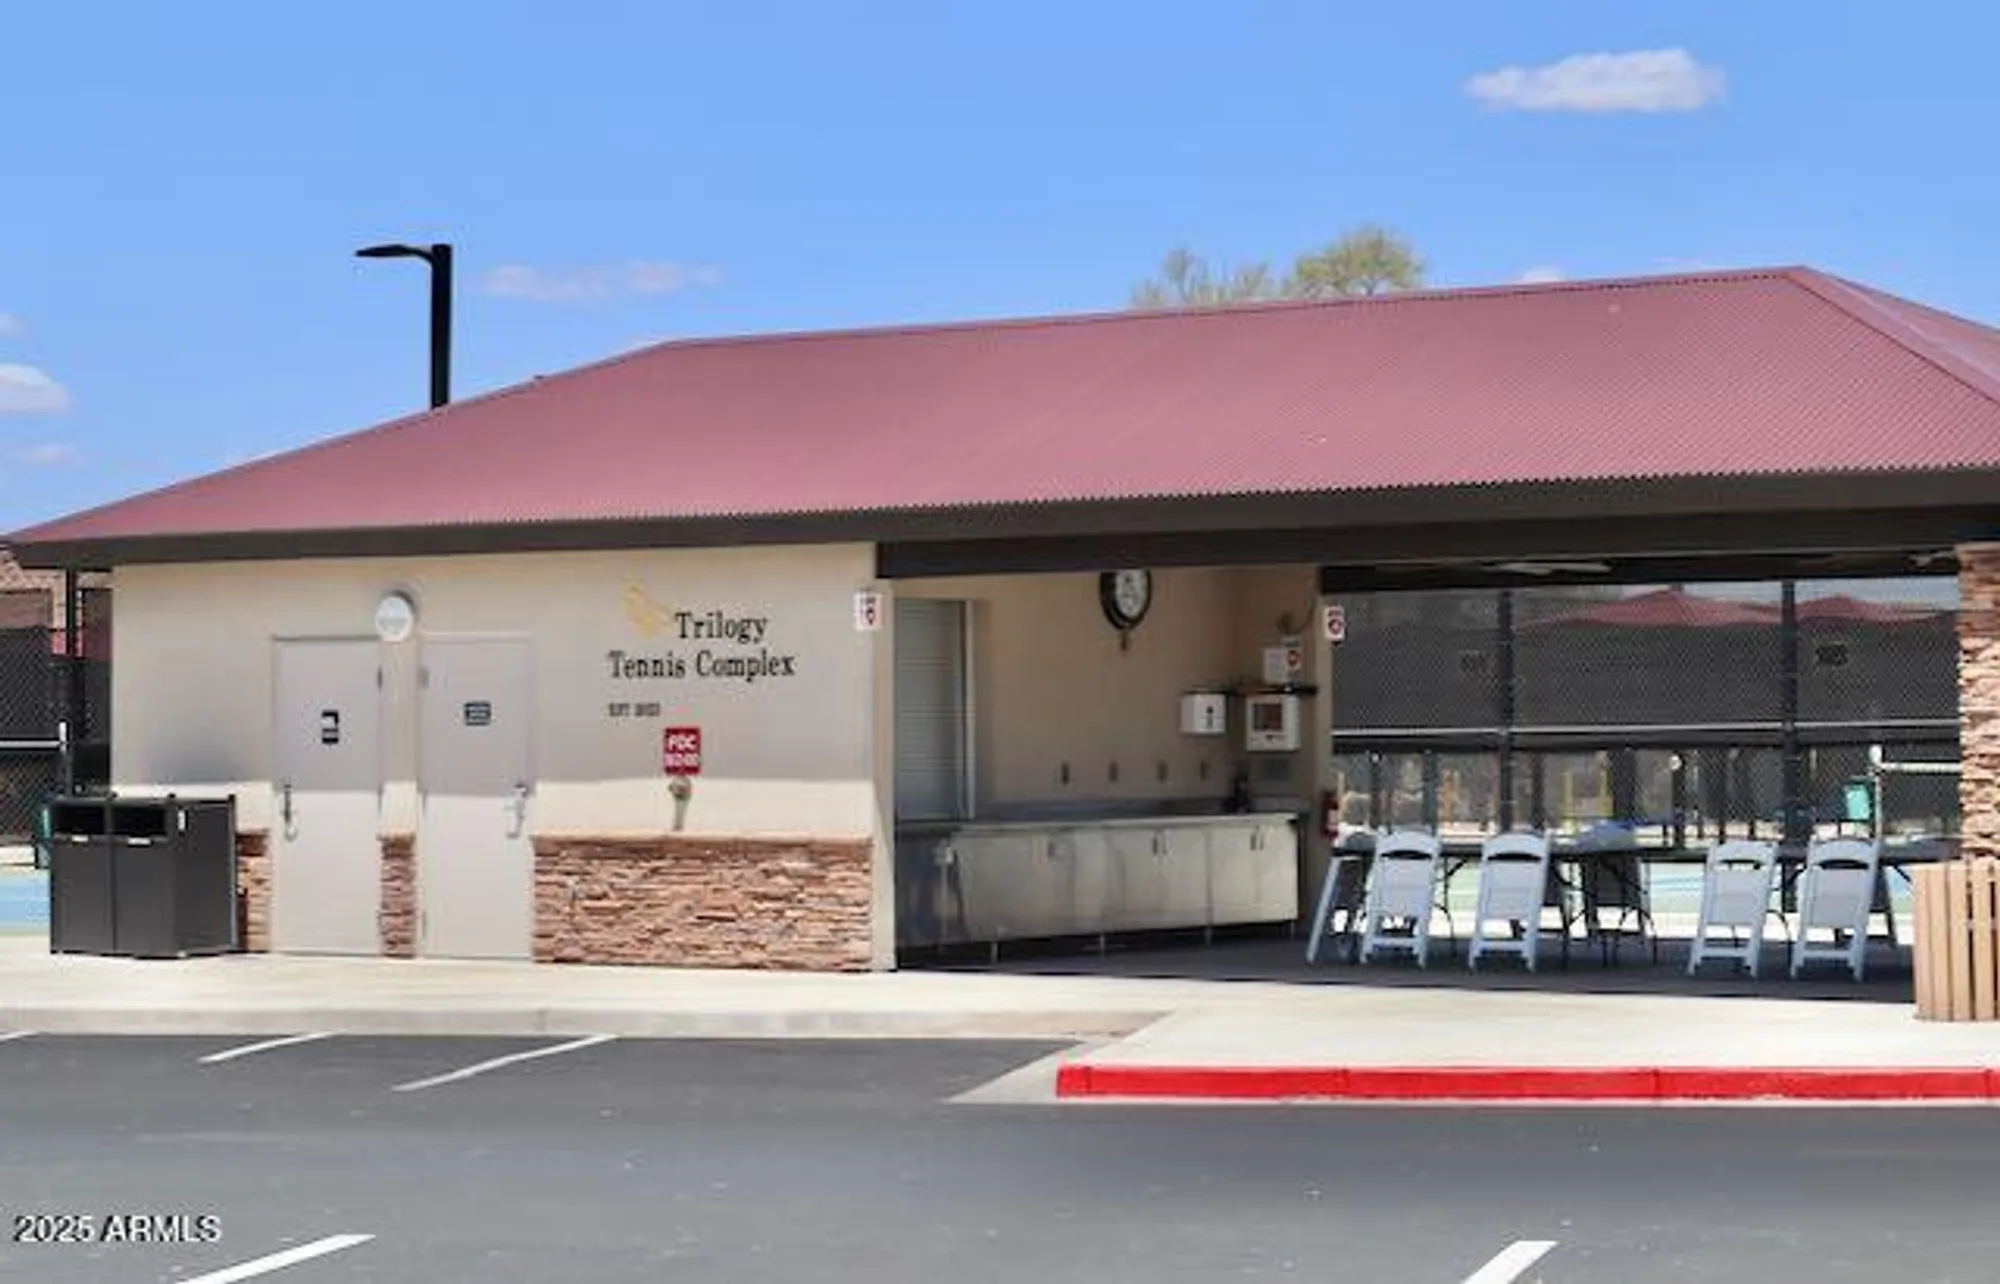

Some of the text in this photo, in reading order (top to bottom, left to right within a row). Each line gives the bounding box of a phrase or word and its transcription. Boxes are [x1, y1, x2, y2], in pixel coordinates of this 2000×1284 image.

[675, 611, 768, 644] Trilogy
[608, 649, 796, 682] Tennis Complex
